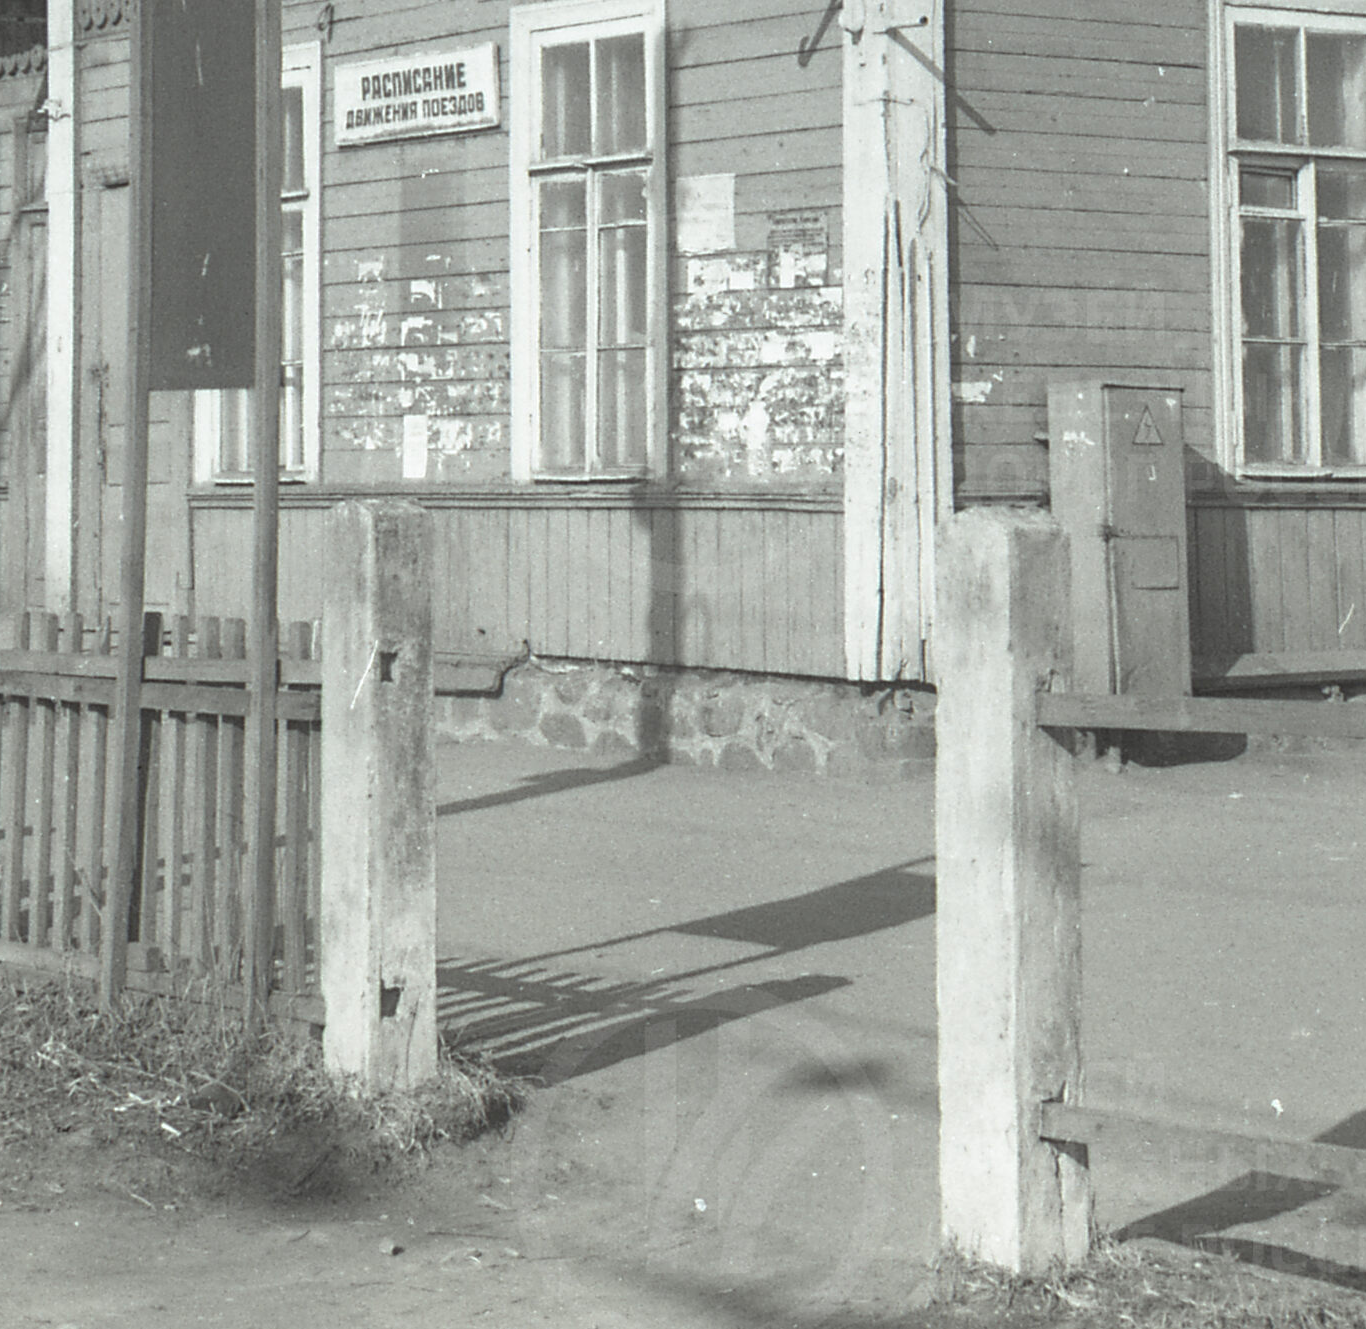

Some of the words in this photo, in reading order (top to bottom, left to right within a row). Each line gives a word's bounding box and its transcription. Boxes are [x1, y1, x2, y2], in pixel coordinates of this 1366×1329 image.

[361, 62, 466, 100] РАСПИСАНИЕ
[346, 101, 418, 129] ДВИЖЕНИЯ
[422, 91, 485, 118] ПОЕЗДОВ
